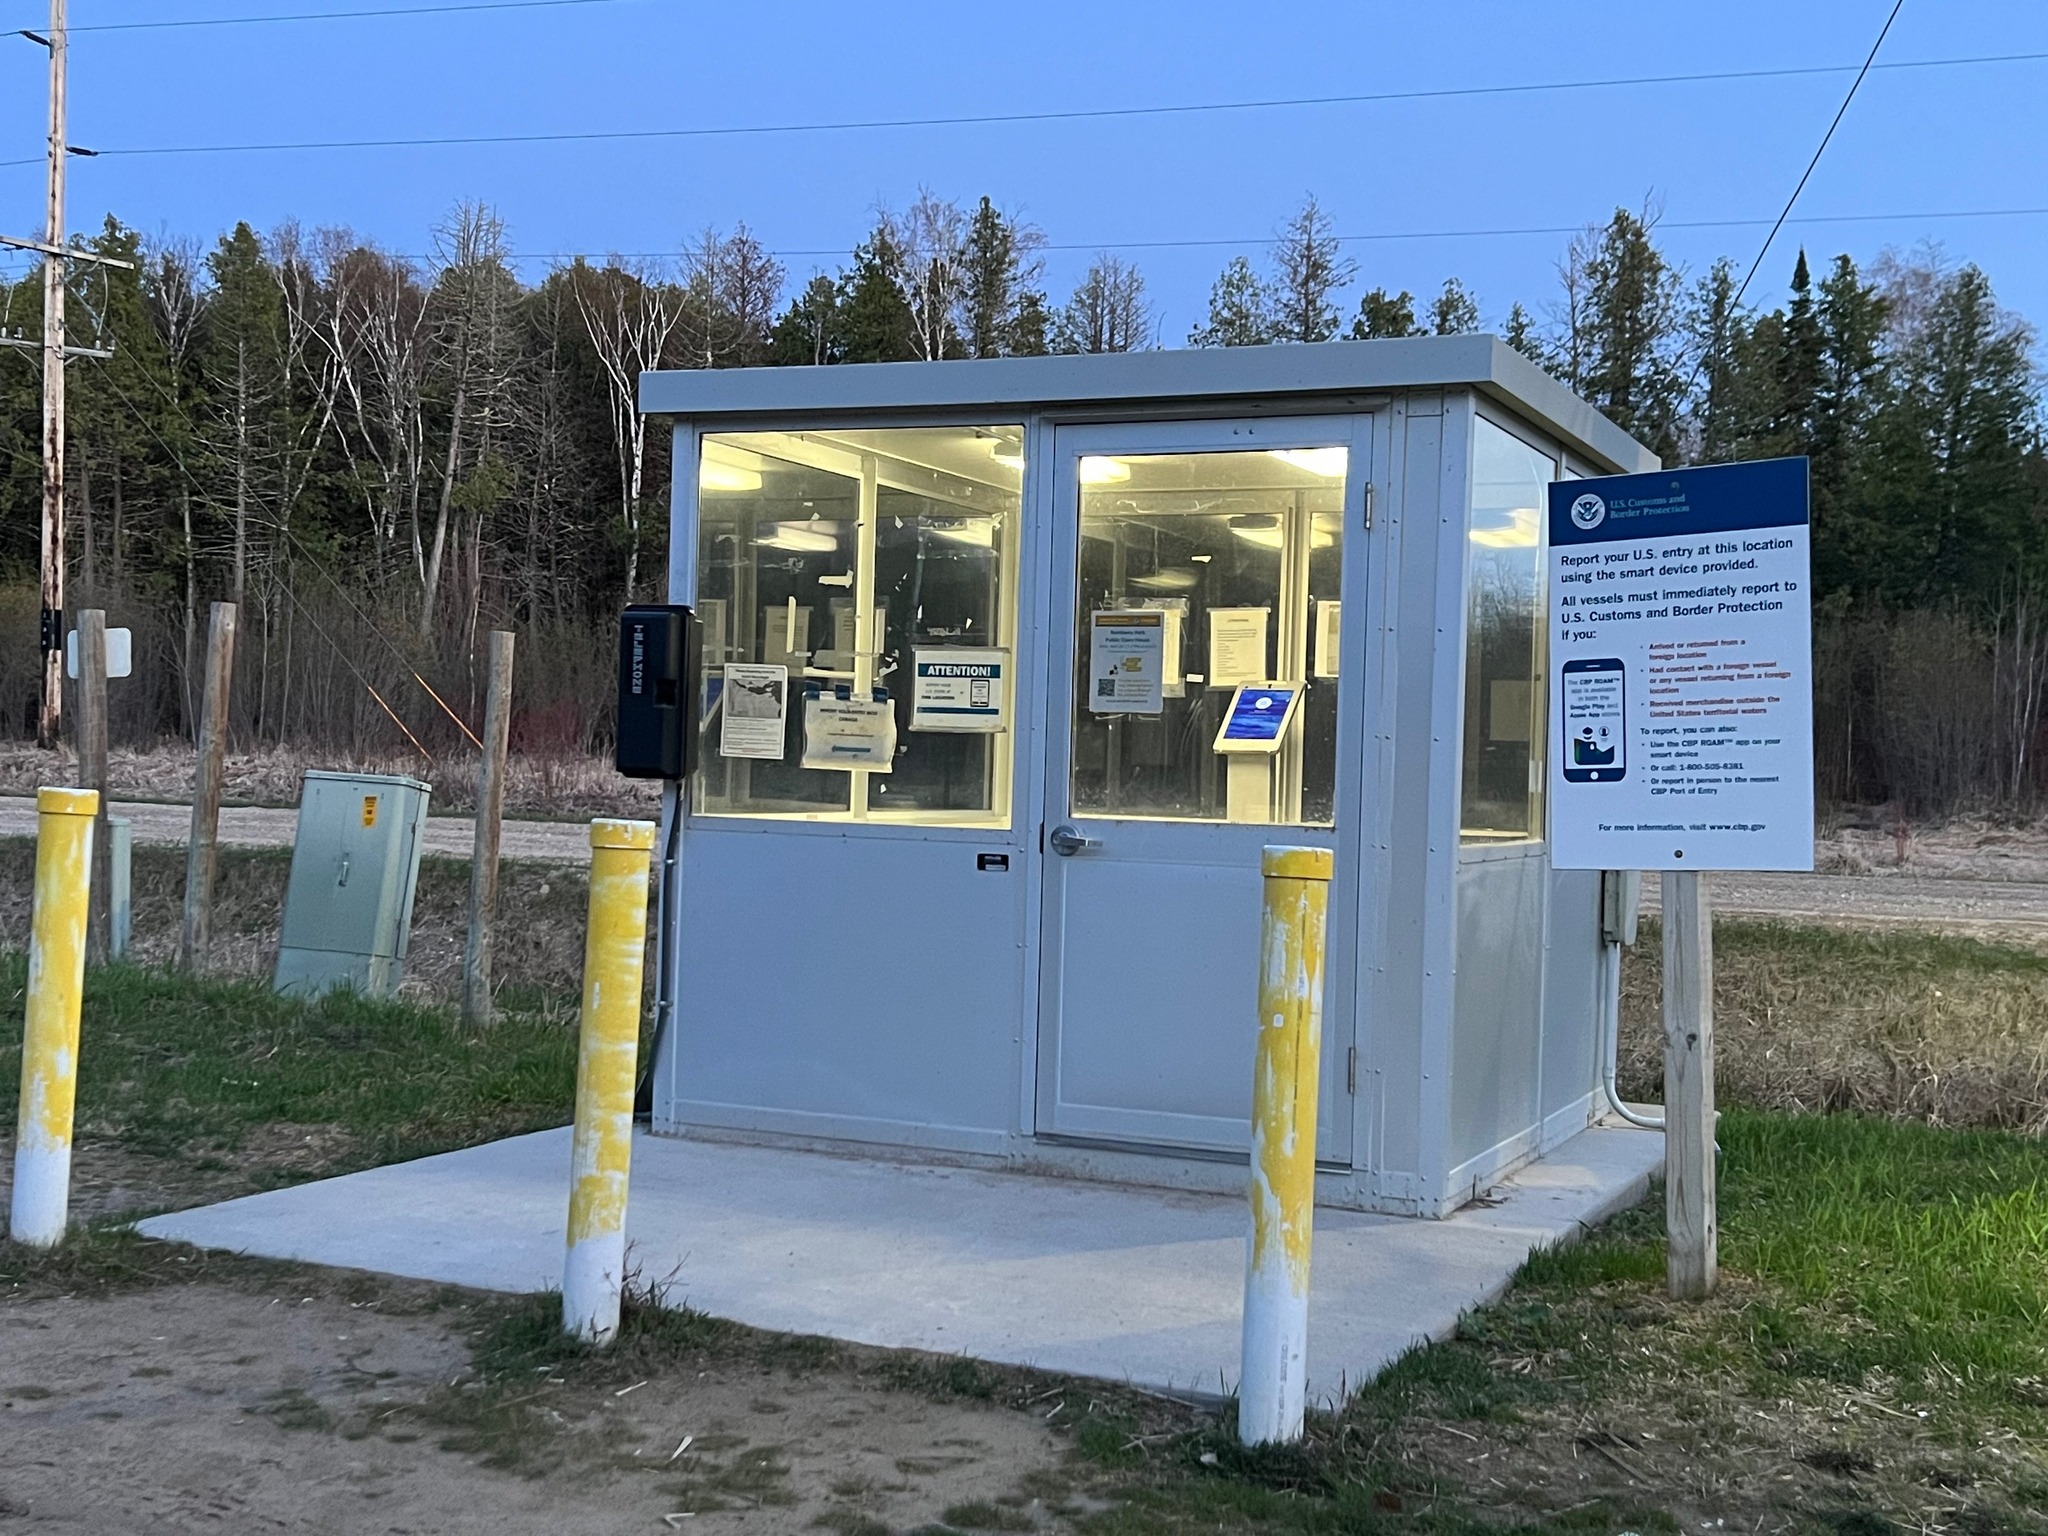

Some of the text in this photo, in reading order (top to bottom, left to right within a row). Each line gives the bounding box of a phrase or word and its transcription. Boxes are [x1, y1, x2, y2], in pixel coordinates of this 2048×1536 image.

[1627, 498, 1667, 508] Customs
[1668, 493, 1686, 503] and
[1610, 504, 1690, 518] Border Protection
[1561, 538, 1793, 568] Report your U.S. entry at this location
[1561, 558, 1759, 584] using the smart device provided.
[1561, 581, 1798, 607] All vessels must immediately report to
[1561, 600, 1783, 624] U.S. Customs and Border Protection
[1572, 630, 1597, 643] you:
[1649, 642, 1675, 650] Arrived
[1687, 640, 1719, 649] returned
[632, 624, 644, 694] TELEPHONE
[1649, 651, 1707, 661] foreign location
[926, 665, 991, 677] ATTENTION!
[1666, 665, 1695, 673] contact
[1697, 663, 1714, 671] with
[1723, 663, 1750, 671] foreign
[1752, 661, 1777, 669] vessel
[1659, 677, 1672, 685] any
[1674, 675, 1698, 683] vessel
[1700, 674, 1735, 682] returning
[1737, 672, 1754, 680] from
[1764, 671, 1791, 679] foreign
[1649, 699, 1683, 707] Received
[1685, 697, 1734, 706] merchandise
[1767, 695, 1780, 703] the
[1676, 709, 1701, 717] States
[1703, 708, 1739, 716] territorial
[1640, 727, 1650, 735] To
[1652, 727, 1680, 736] report,
[1682, 727, 1697, 736] you
[1717, 725, 1738, 733] also:
[1650, 740, 1664, 748] Use
[1681, 739, 1699, 747] CBP
[1764, 738, 1781, 746] your
[1674, 750, 1699, 758] device
[1650, 764, 1660, 772] Or
[1650, 777, 1660, 785] Or
[1661, 777, 1685, 785] report
[1686, 776, 1694, 784] in
[1695, 777, 1722, 785] person
[1749, 775, 1780, 783] nearest
[1650, 787, 1668, 795] CBP
[1669, 787, 1686, 795] Port
[1697, 787, 1718, 795] Entry
[1598, 823, 1612, 831] For
[1636, 823, 1686, 832] information,
[1688, 823, 1707, 831] visit
[1708, 822, 1767, 832] www.cbp.gov
